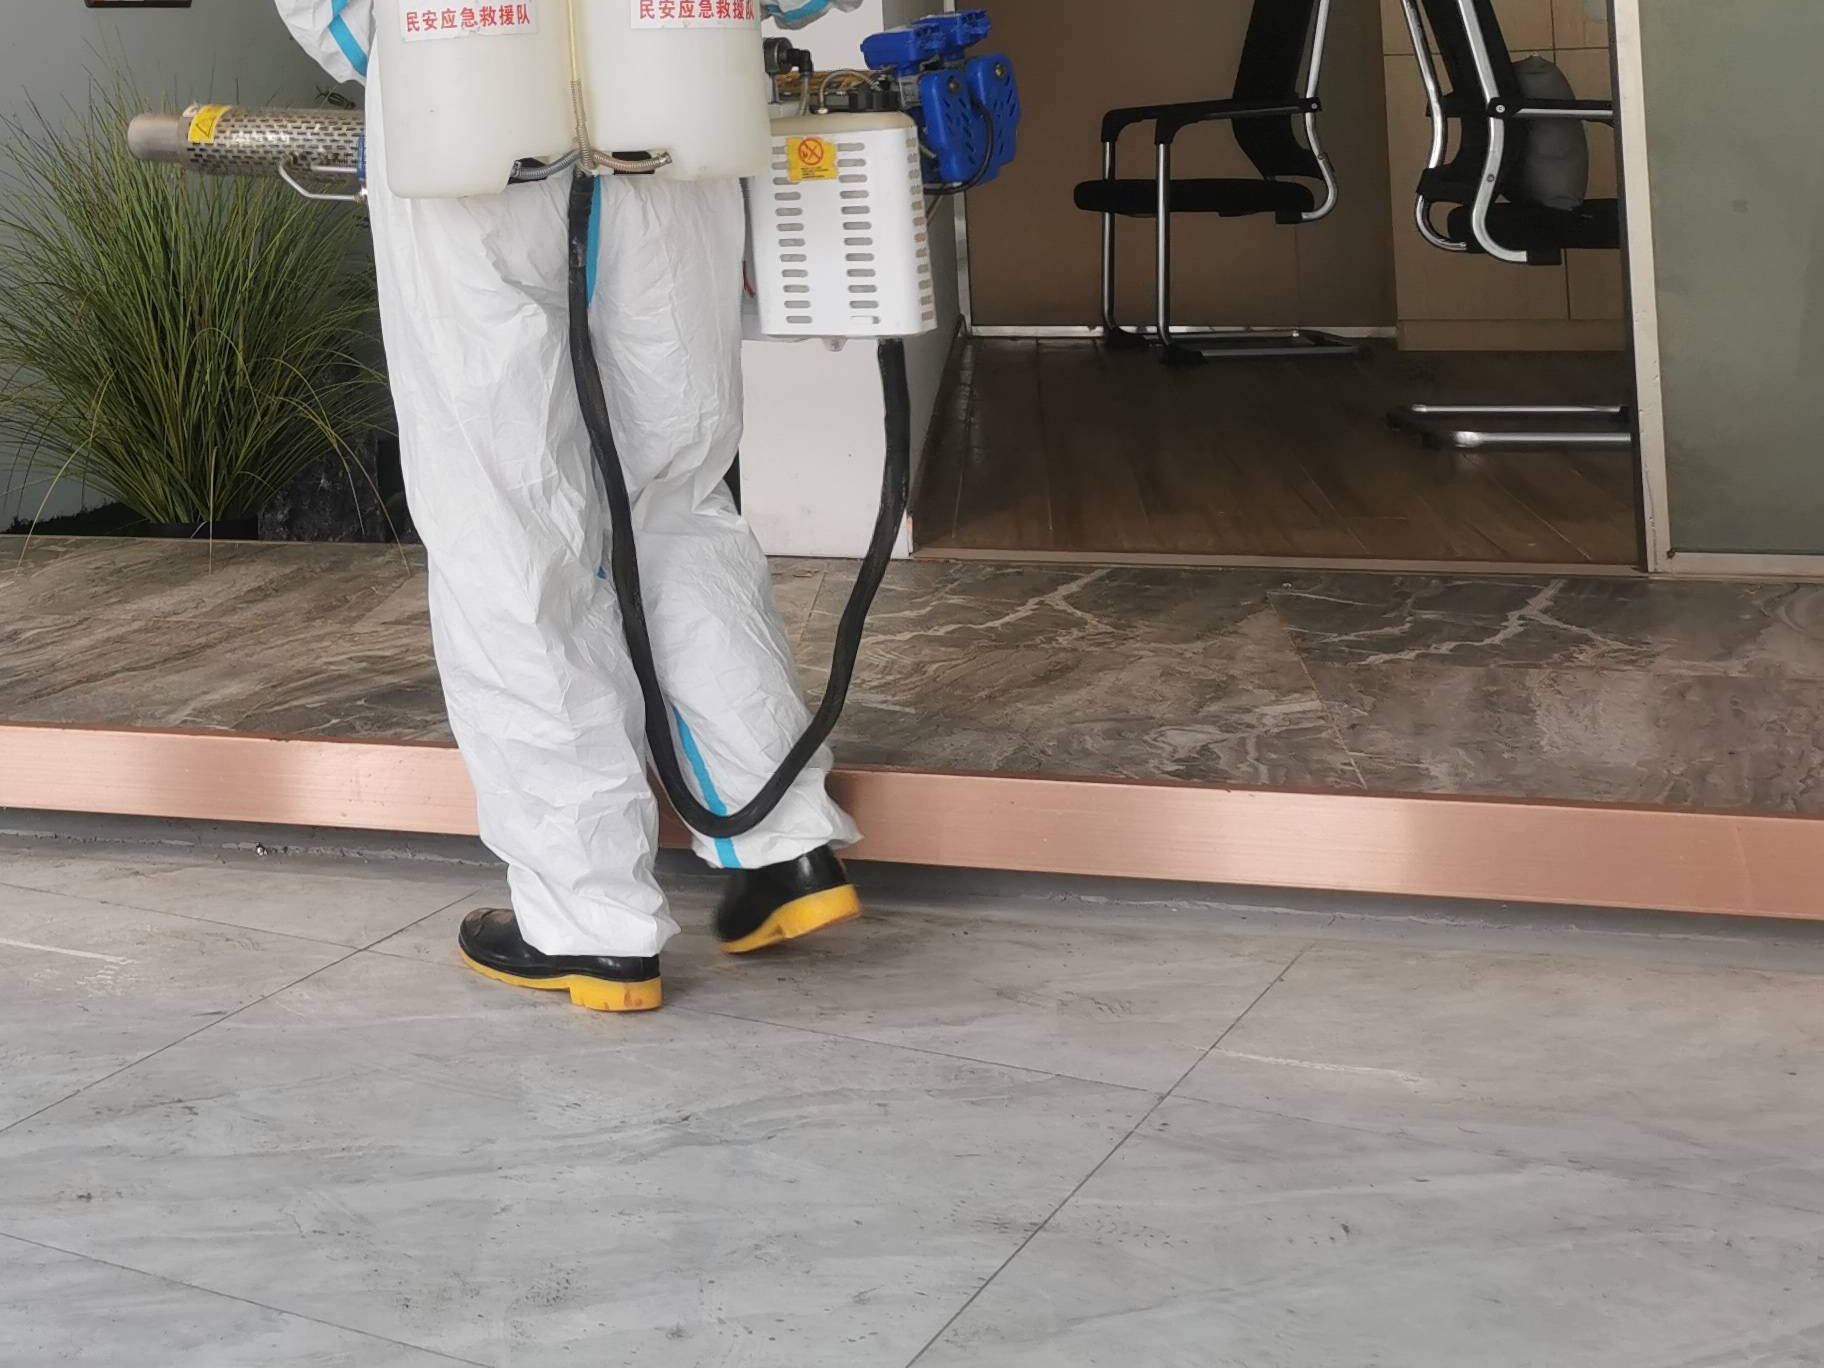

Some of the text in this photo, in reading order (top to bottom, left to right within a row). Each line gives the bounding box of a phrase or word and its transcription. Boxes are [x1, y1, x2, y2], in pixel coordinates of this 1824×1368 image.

[406, 3, 531, 33] 民安应急救援队
